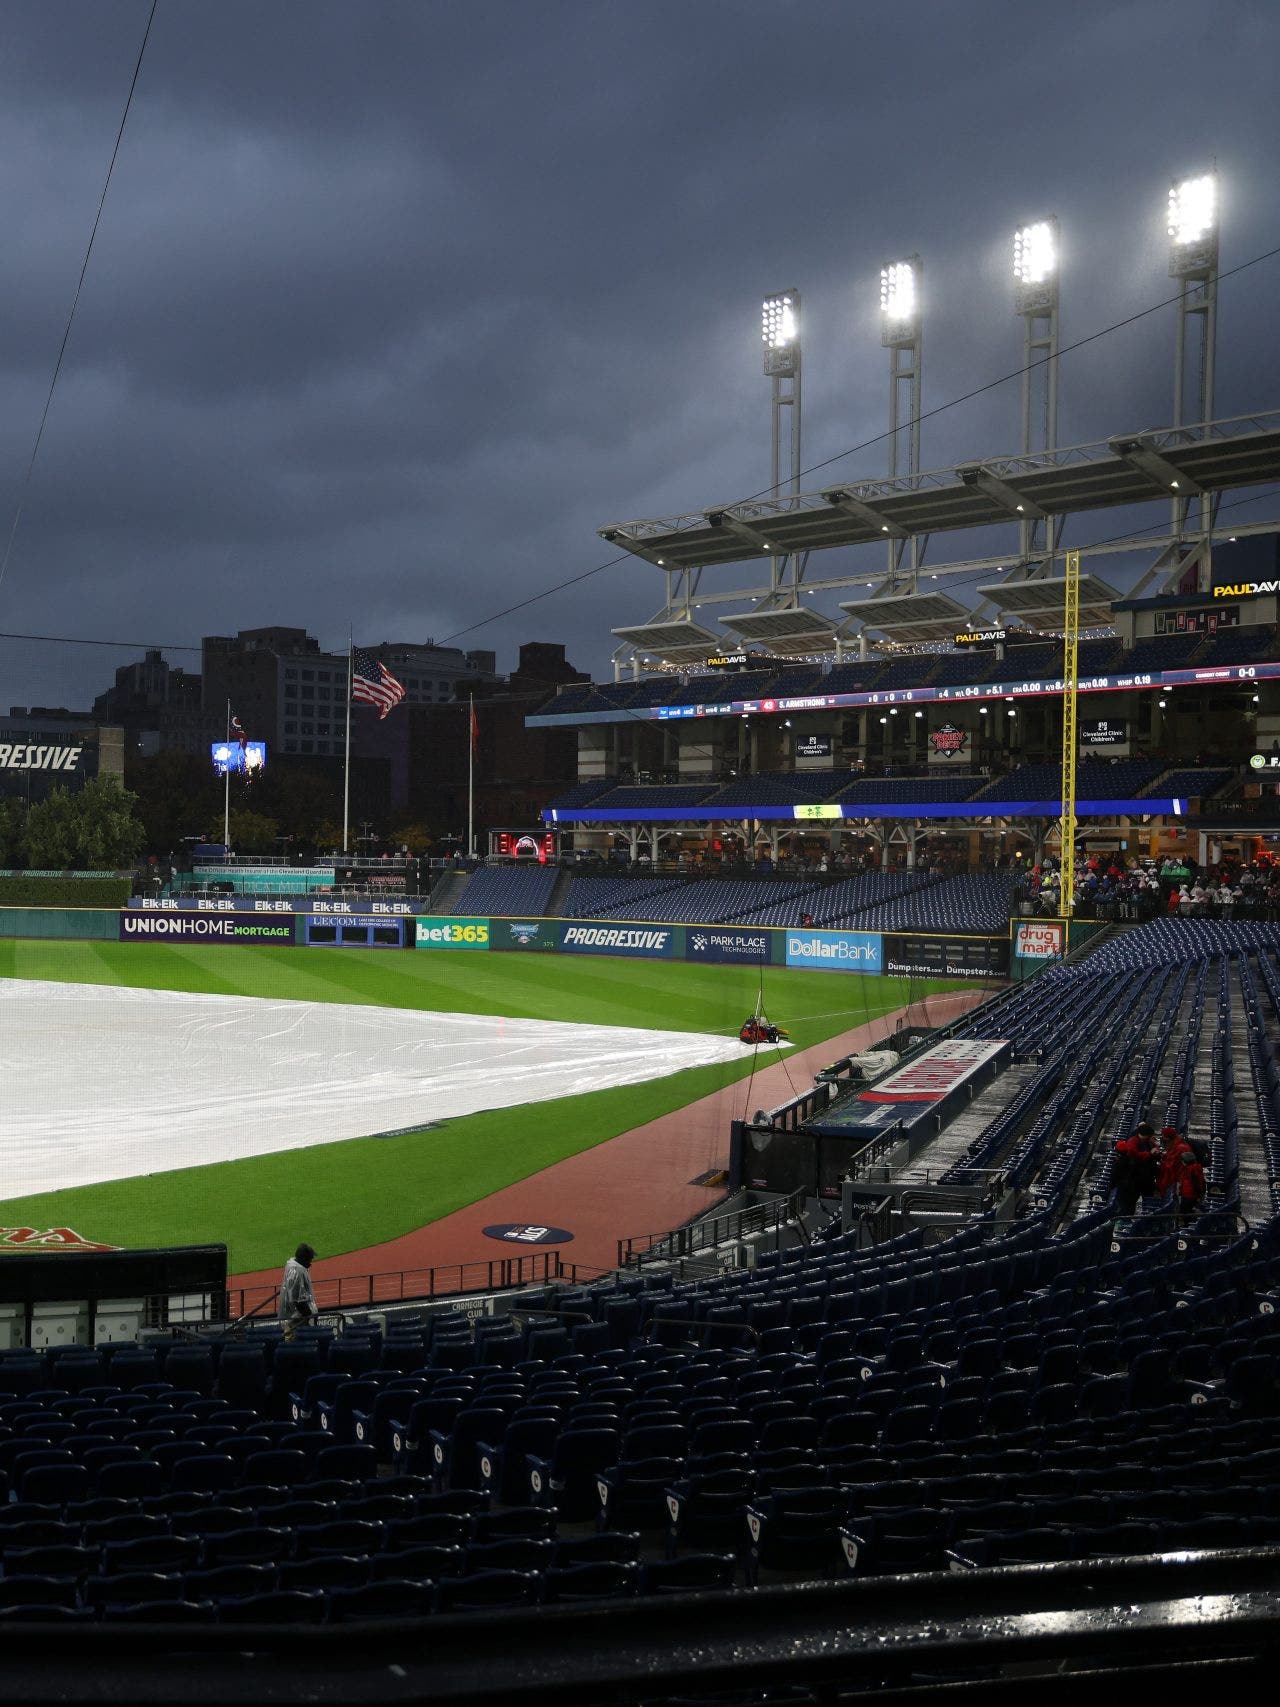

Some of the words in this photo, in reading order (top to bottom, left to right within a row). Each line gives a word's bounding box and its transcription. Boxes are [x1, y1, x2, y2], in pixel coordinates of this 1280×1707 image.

[966, 688, 978, 696] 0-0
[1022, 683, 1040, 692] 0.00
[1239, 668, 1255, 677] 0-0
[786, 698, 825, 708] ARMSTRONG
[22, 869, 64, 878] PROGRESSIVE
[72, 870, 116, 879] PROGRESSIVE
[417, 924, 488, 942] bet365
[564, 927, 669, 949] PROGRESSIVE
[1020, 928, 1053, 944] drug
[711, 936, 734, 946] PARK
[736, 937, 766, 947] PLACE
[722, 946, 766, 954] TECHNOLOGIES
[1023, 943, 1058, 954] mart
